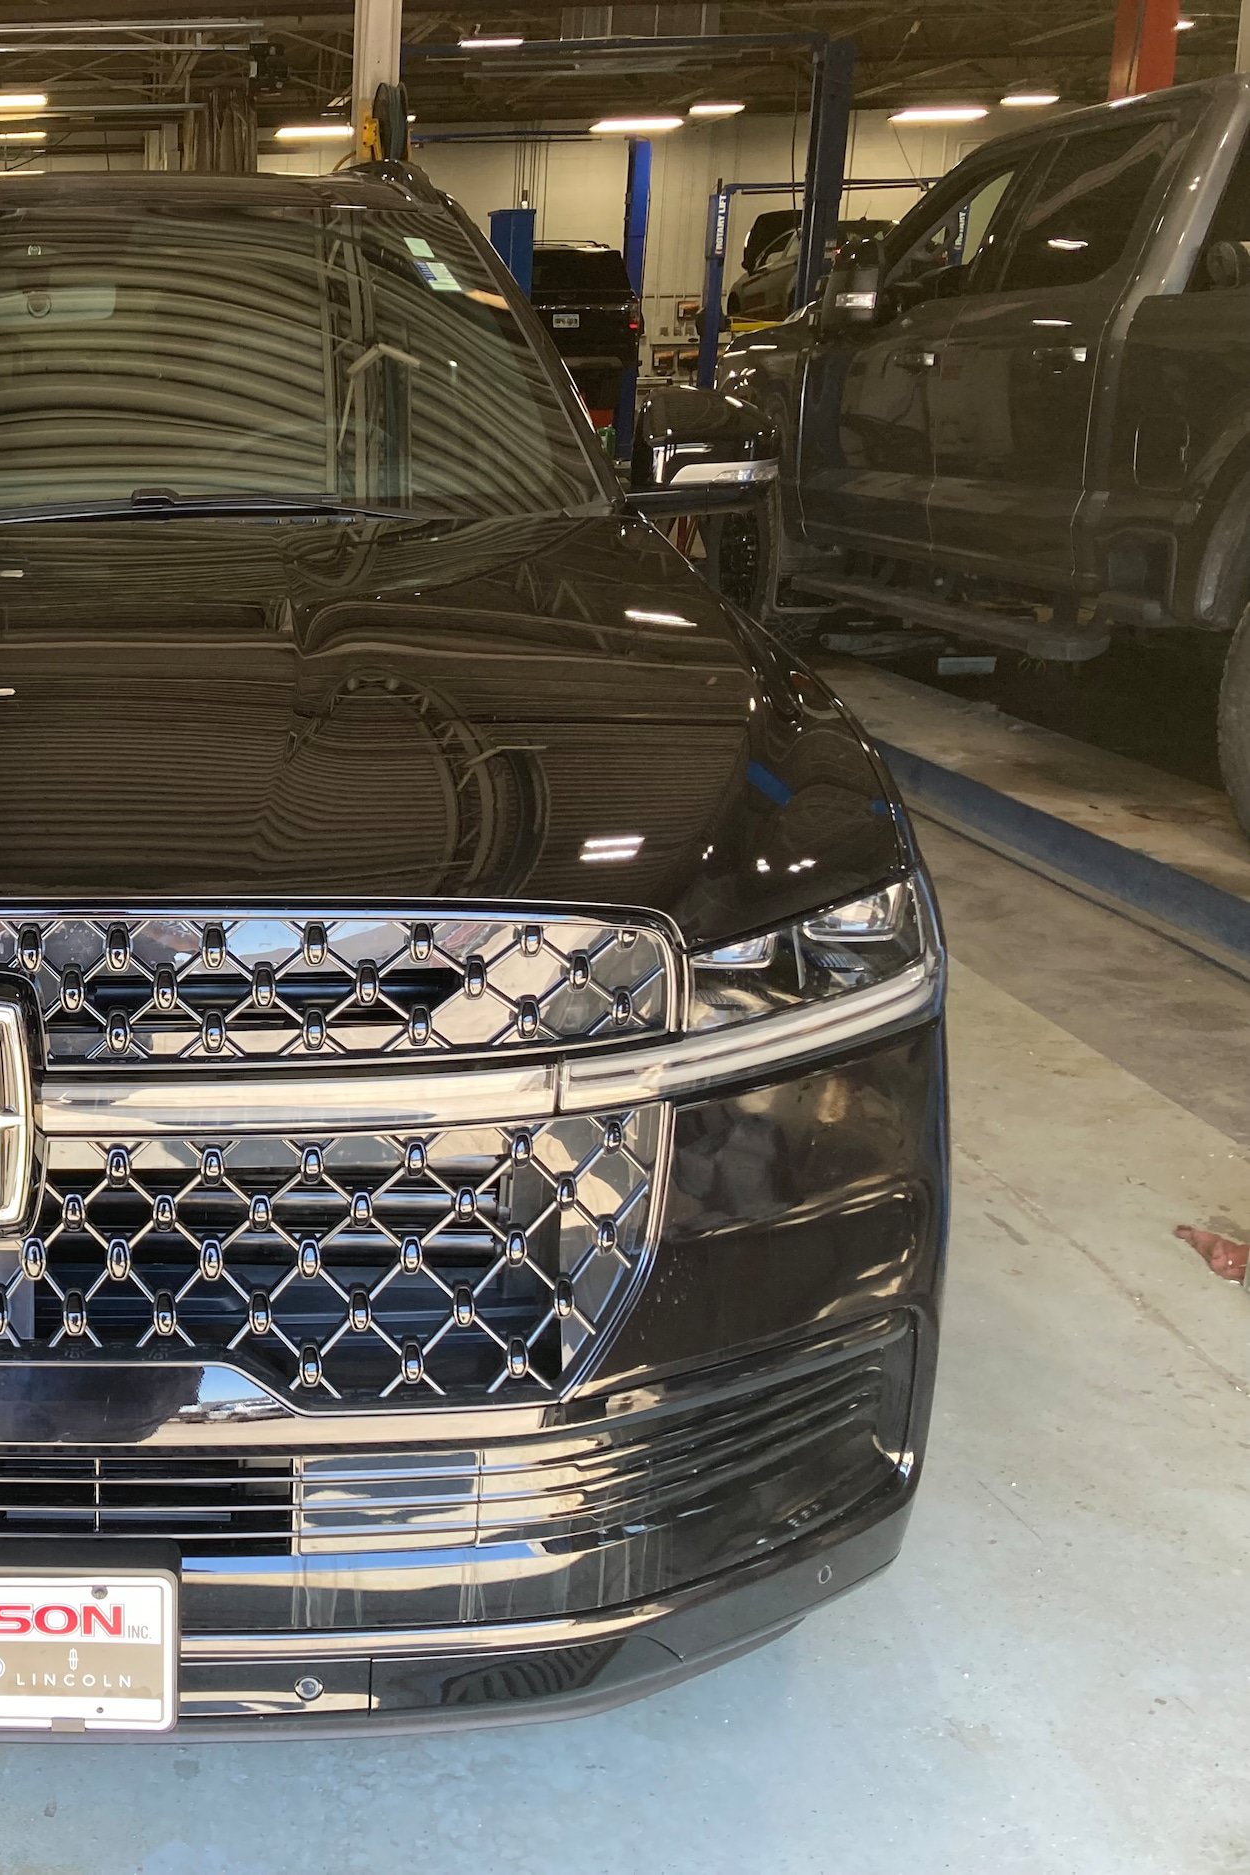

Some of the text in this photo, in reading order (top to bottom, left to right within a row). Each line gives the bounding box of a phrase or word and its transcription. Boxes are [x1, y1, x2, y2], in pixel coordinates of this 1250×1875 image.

[715, 195, 727, 250] ROTARY LIFT
[127, 1624, 153, 1640] INC.
[16, 1673, 133, 1689] LINCOLN
